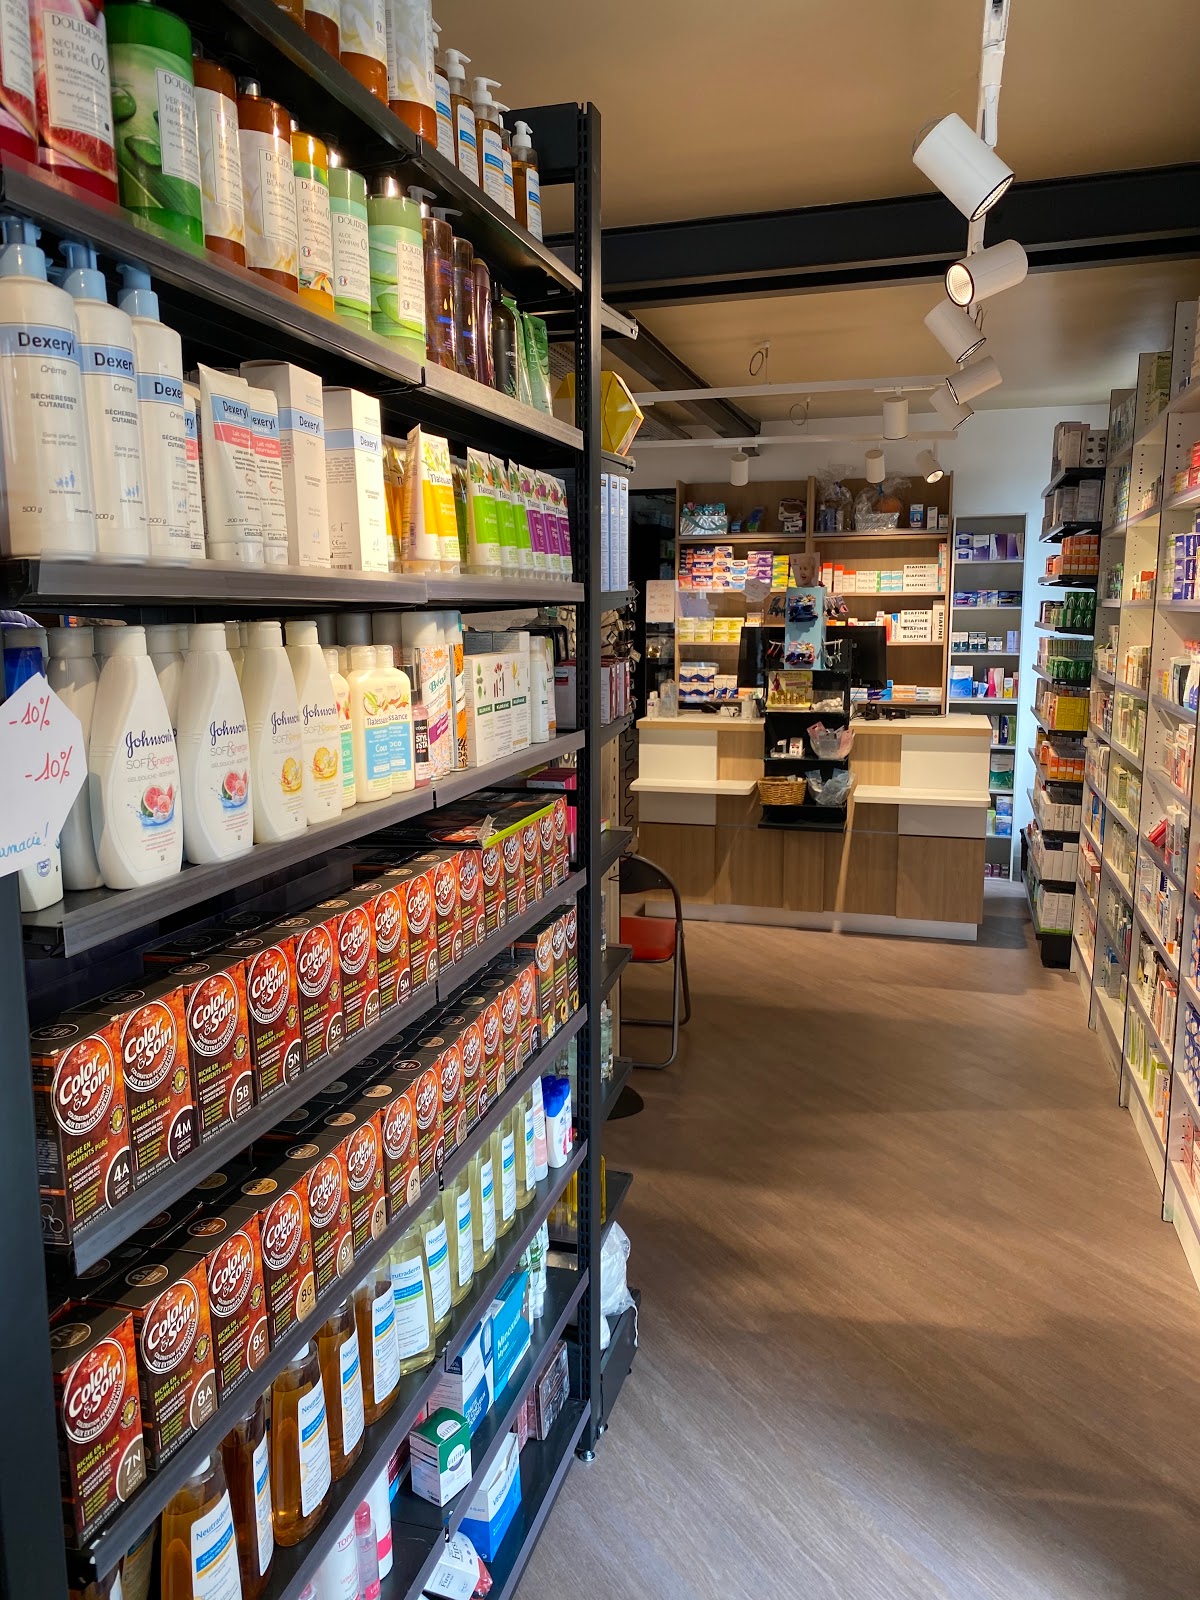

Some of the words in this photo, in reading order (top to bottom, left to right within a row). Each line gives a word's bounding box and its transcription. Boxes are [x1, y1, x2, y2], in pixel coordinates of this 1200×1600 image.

[52, 38, 86, 54] NECTAR
[53, 47, 65, 58] DE
[67, 51, 90, 66] FIGUE
[18, 332, 75, 355] Dexeryl
[40, 364, 67, 376] Crème
[30, 392, 77, 404] SÉCHERESSES
[113, 383, 133, 394] Crème
[38, 400, 74, 410] CUTANÉES
[223, 400, 249, 419] Dexeryl
[300, 416, 320, 433] Dexeryl
[360, 435, 379, 451] Dexeryl
[375, 901, 395, 931] Color
[386, 910, 400, 935] Soin
[340, 920, 363, 951] Color
[352, 926, 369, 955] Soin
[300, 938, 324, 973] Color
[313, 946, 331, 977] Soin
[252, 961, 280, 999] Color
[267, 969, 286, 1002] Soin
[400, 977, 409, 991] 5M
[193, 988, 227, 1029] Color
[212, 996, 234, 1032] Soin
[366, 1001, 379, 1016] 5GM
[124, 1017, 162, 1064] Color
[330, 1023, 341, 1040] 5G
[146, 1025, 172, 1066] Soin
[198, 1066, 212, 1079] RICHE
[212, 1062, 219, 1071] EN
[199, 1069, 221, 1085] PIGMENTS
[221, 1061, 233, 1072] PURS
[288, 1051, 300, 1068] 5N
[60, 1053, 100, 1105] Color
[82, 1062, 109, 1107] Soin
[131, 1104, 147, 1116] RICHE
[147, 1098, 154, 1107] EN
[236, 1085, 249, 1102] 5B
[132, 1106, 158, 1123] PIGMENTS
[158, 1096, 171, 1108] PURS
[174, 1119, 191, 1138] 4M
[67, 1146, 83, 1161] RICHE
[83, 1141, 91, 1151] EN
[68, 1148, 95, 1170] PIGMENTS
[95, 1138, 109, 1152] PURS
[113, 1162, 129, 1182] 4A
[310, 1167, 334, 1207] Color
[323, 1173, 340, 1206] Soin
[267, 1204, 294, 1249] Color
[280, 1209, 299, 1247] Soin
[212, 1245, 243, 1295] Color
[229, 1250, 251, 1292] Soin
[301, 1284, 312, 1303] 8G
[148, 1294, 186, 1350] Color
[169, 1301, 195, 1346] Soin
[253, 1329, 265, 1350] 8C
[69, 1355, 111, 1418] Color
[92, 1362, 121, 1414] Soin
[154, 1382, 170, 1399] RICHE
[169, 1374, 177, 1385] EN
[155, 1380, 181, 1406] PIGMENTS
[180, 1368, 193, 1383] PURS
[197, 1385, 213, 1407] 8A
[83, 1418, 106, 1438] EXTRAITS
[76, 1451, 93, 1471] RICHE
[93, 1443, 102, 1455] EN
[77, 1448, 105, 1479] PIGMENTS
[105, 1435, 120, 1452] PURS
[124, 1449, 141, 1477] 7N
